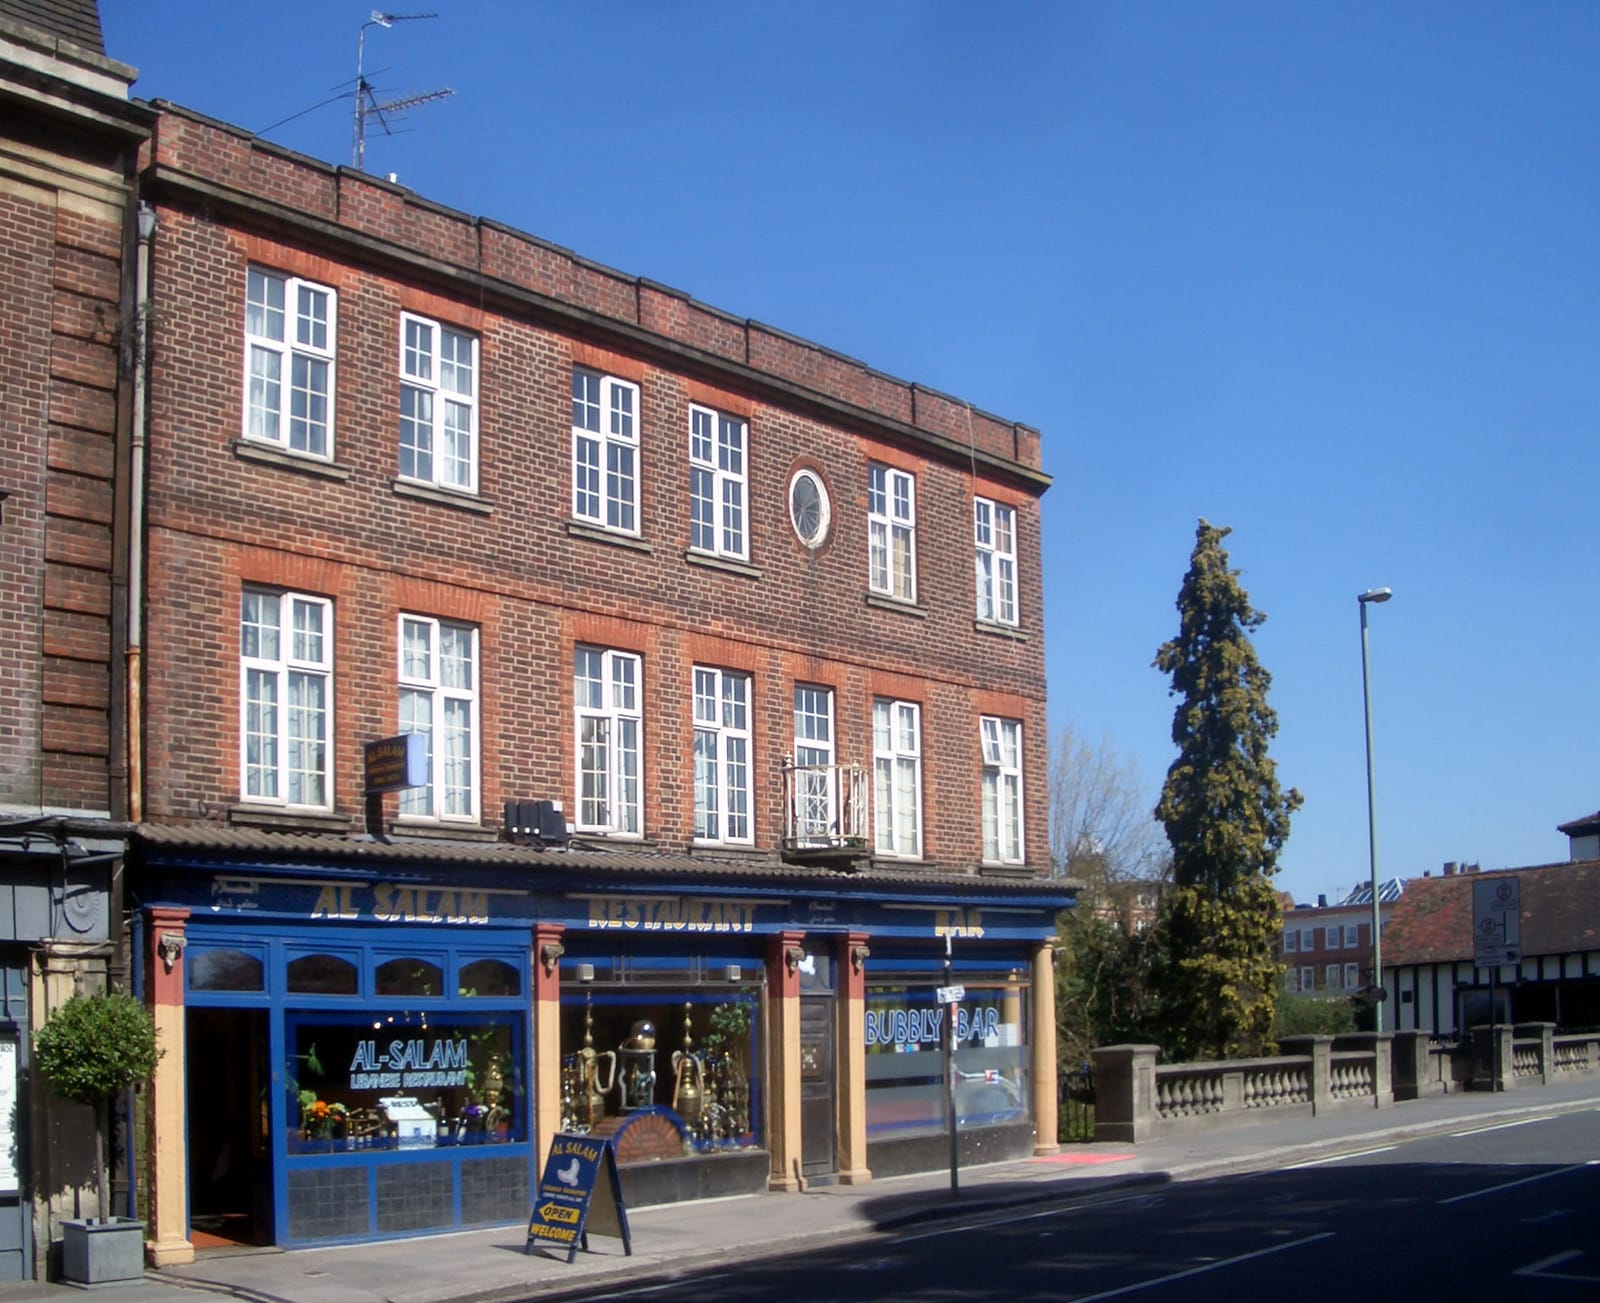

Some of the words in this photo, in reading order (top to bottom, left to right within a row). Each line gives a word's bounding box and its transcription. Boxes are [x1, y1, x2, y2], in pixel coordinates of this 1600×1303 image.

[310, 884, 360, 919] AL
[371, 881, 489, 925] SALAM
[588, 897, 757, 932] RESTAURANT
[935, 908, 984, 938] BAR
[864, 1008, 944, 1045] BUBBLY
[956, 1006, 999, 1042] BAR
[350, 1038, 467, 1071] AL-SALAM
[552, 1144, 562, 1156] AL
[565, 1141, 597, 1161] SALAM
[544, 1206, 573, 1220] OPEN
[531, 1224, 576, 1241] WELCOME
